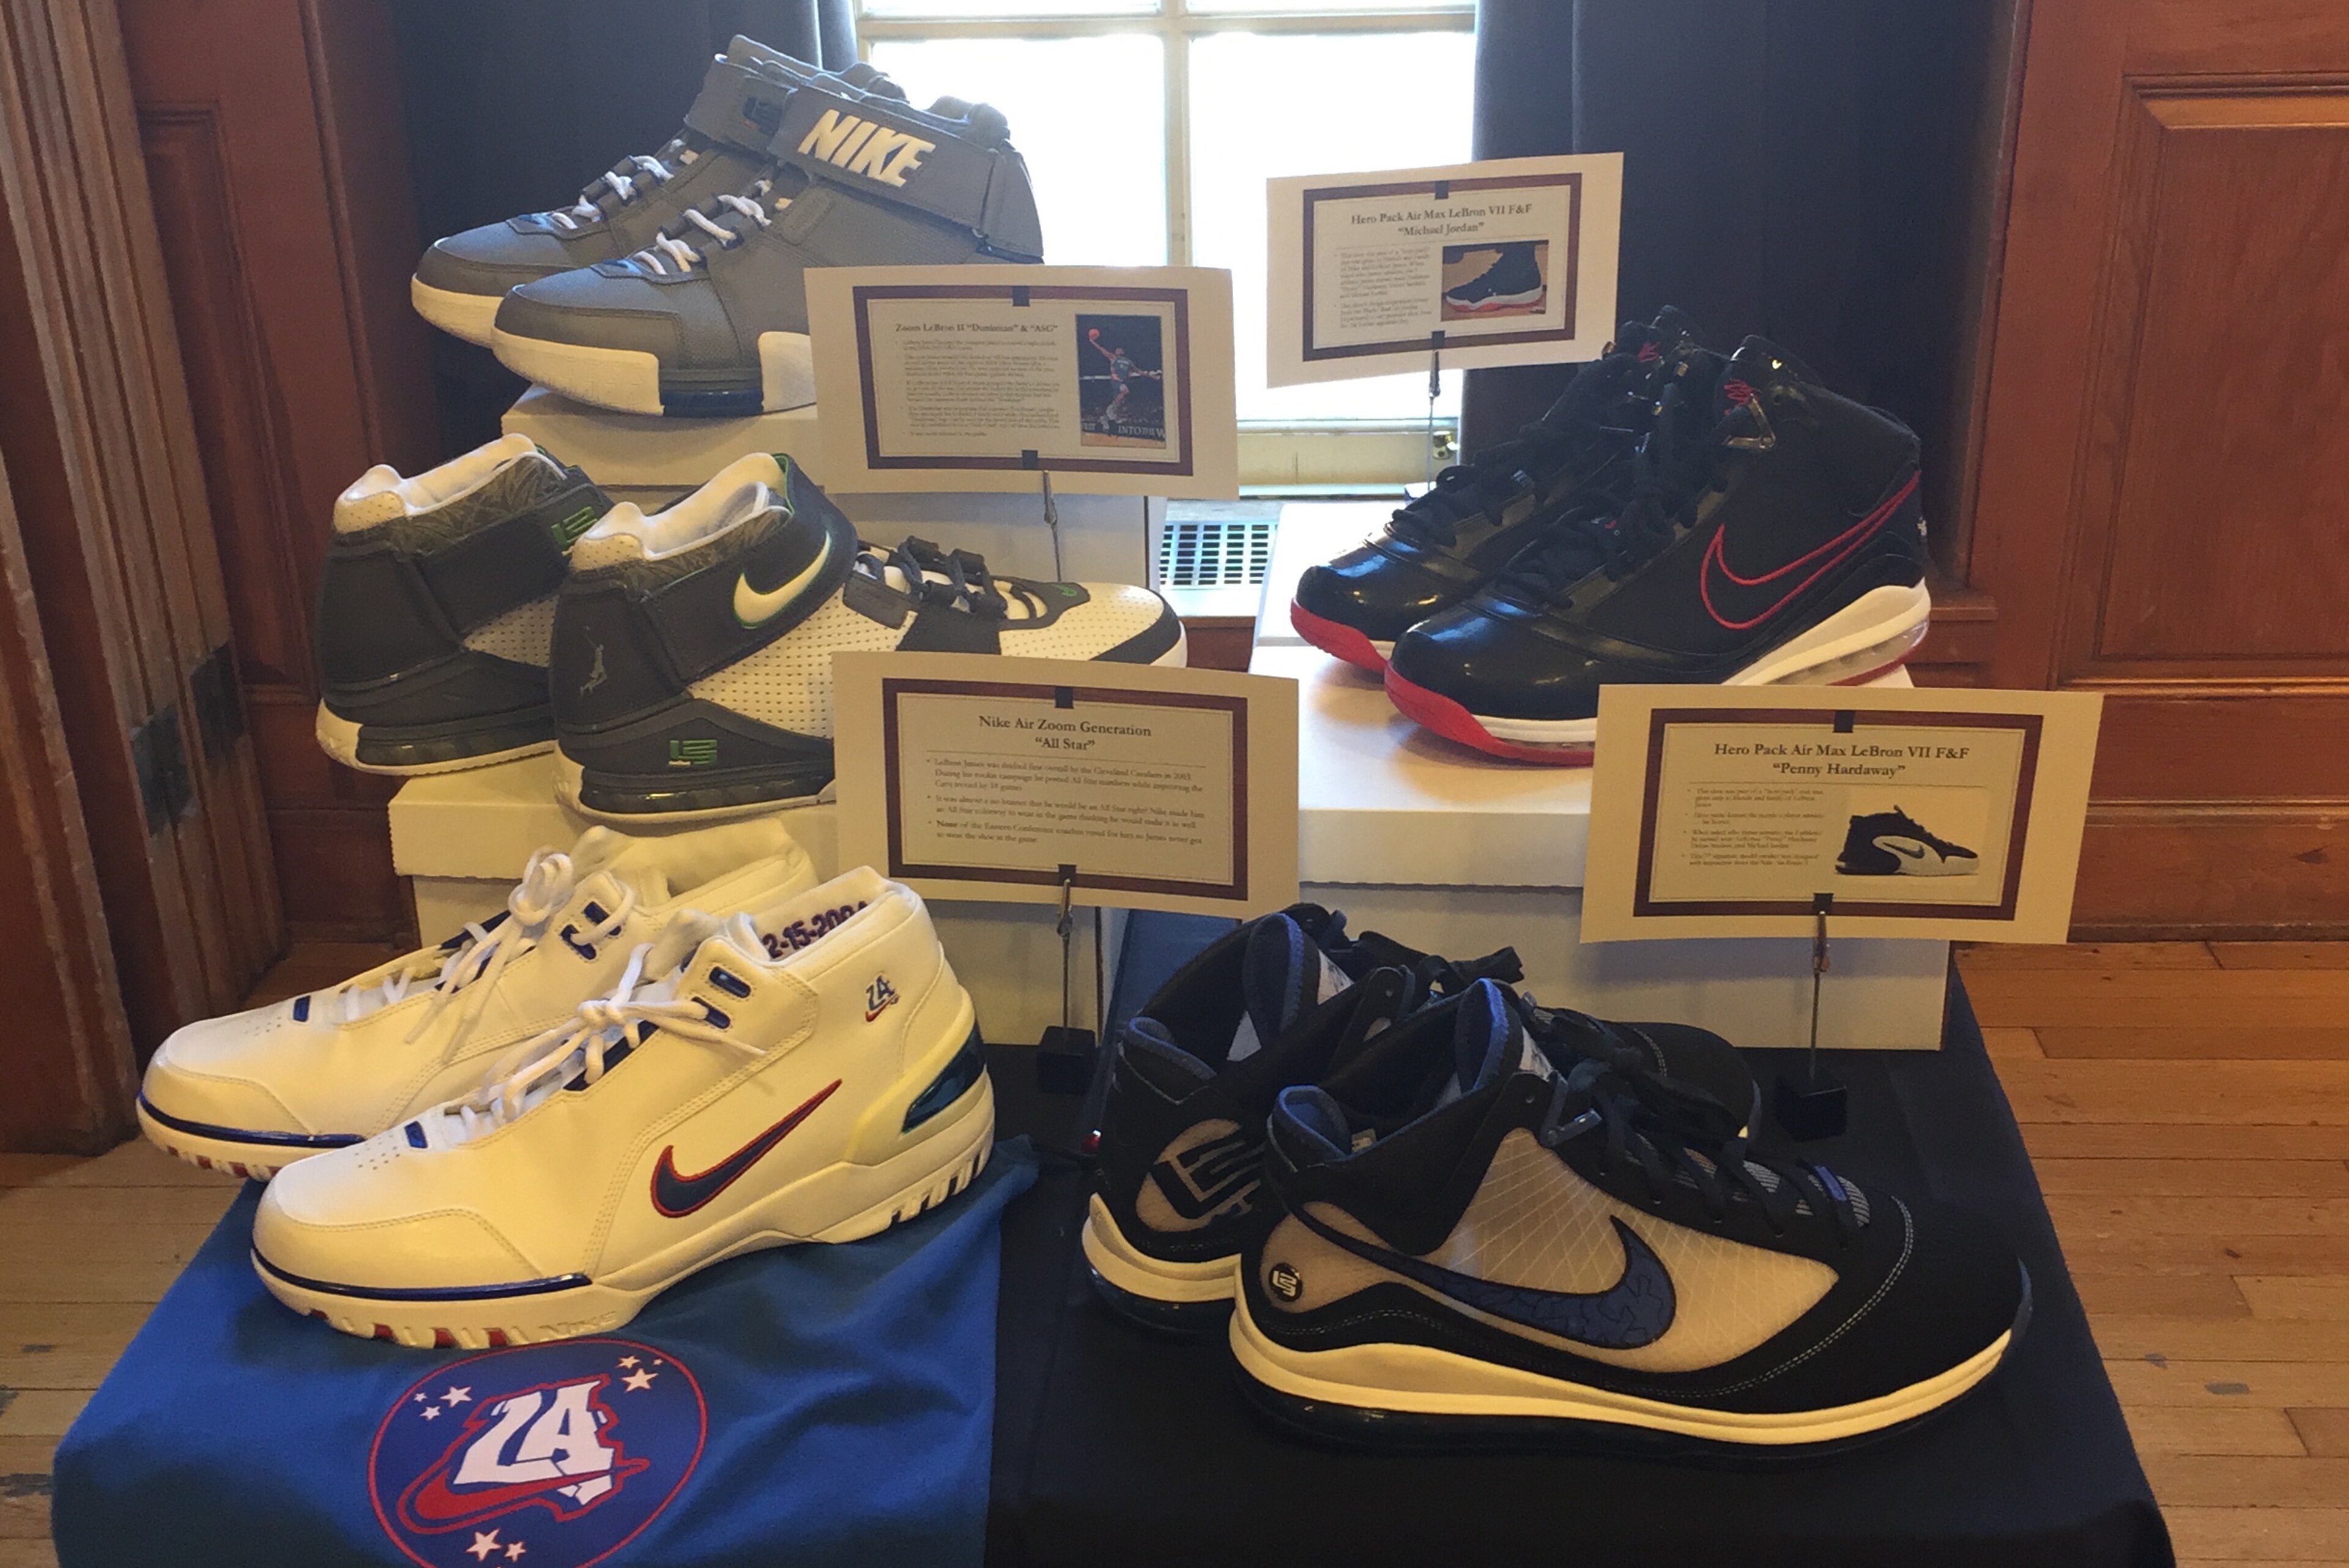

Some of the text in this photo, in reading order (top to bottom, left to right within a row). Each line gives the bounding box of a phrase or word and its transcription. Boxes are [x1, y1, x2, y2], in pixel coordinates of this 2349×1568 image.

[797, 108, 937, 188] NIKE
[1351, 204, 1532, 225] Hero Pack Air Max LeBron VII F&F
[979, 715, 1152, 738] Nike Air Zoom Generation
[1035, 736, 1096, 752] “All Star”
[1715, 743, 1970, 760] Hero Pack Air Max LeBron VII F&F
